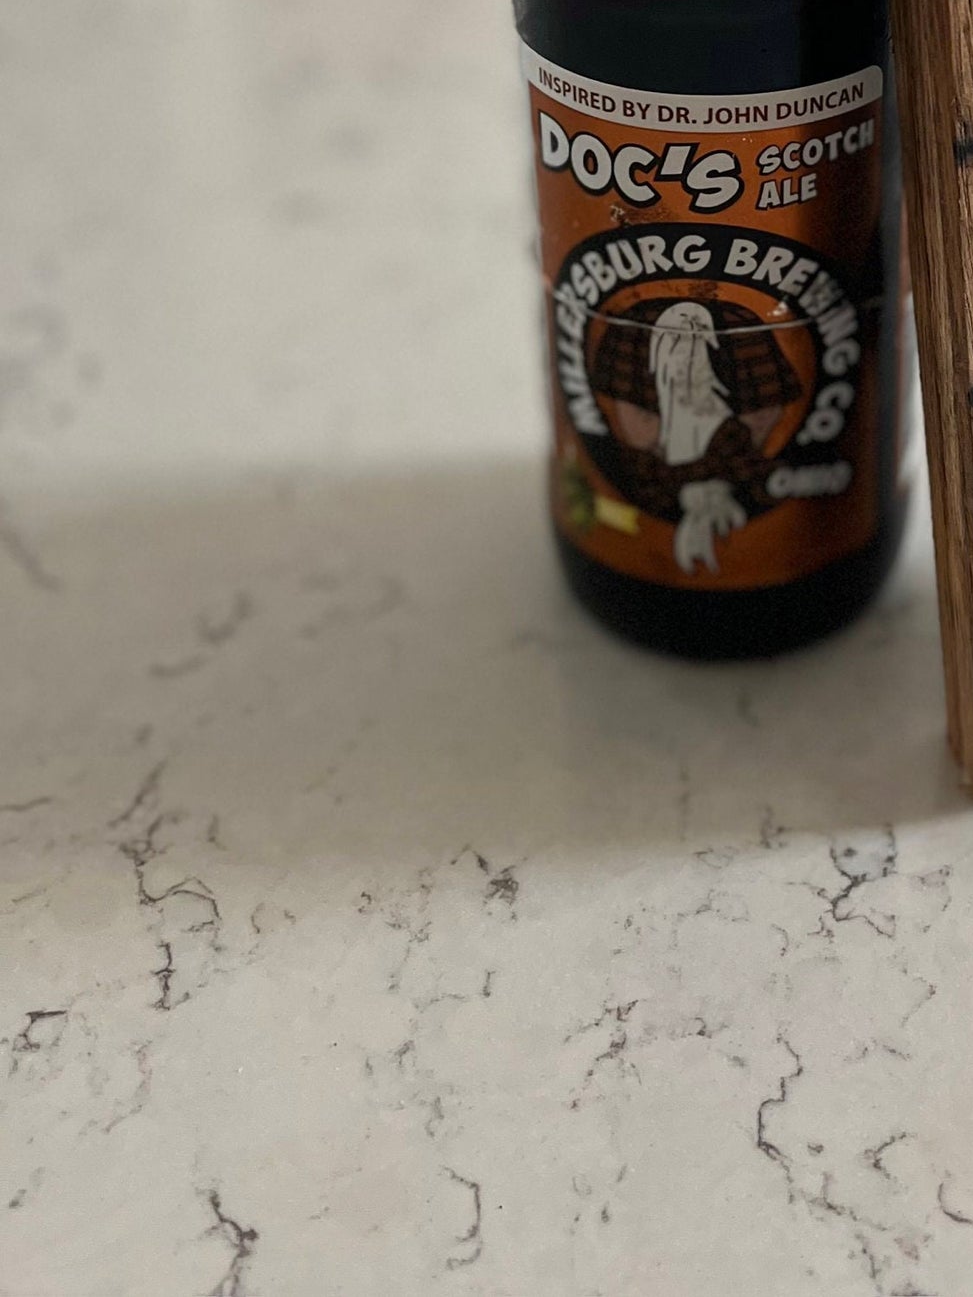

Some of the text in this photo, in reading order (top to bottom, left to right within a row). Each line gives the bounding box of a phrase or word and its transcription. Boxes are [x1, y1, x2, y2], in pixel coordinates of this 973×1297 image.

[538, 66, 865, 125] INSPIRED BY DR. JOHN DUNCAN
[538, 112, 743, 213] DOC'S
[756, 118, 875, 176] SCOTCH
[756, 173, 820, 210] ALE
[724, 238, 861, 376] BREWING
